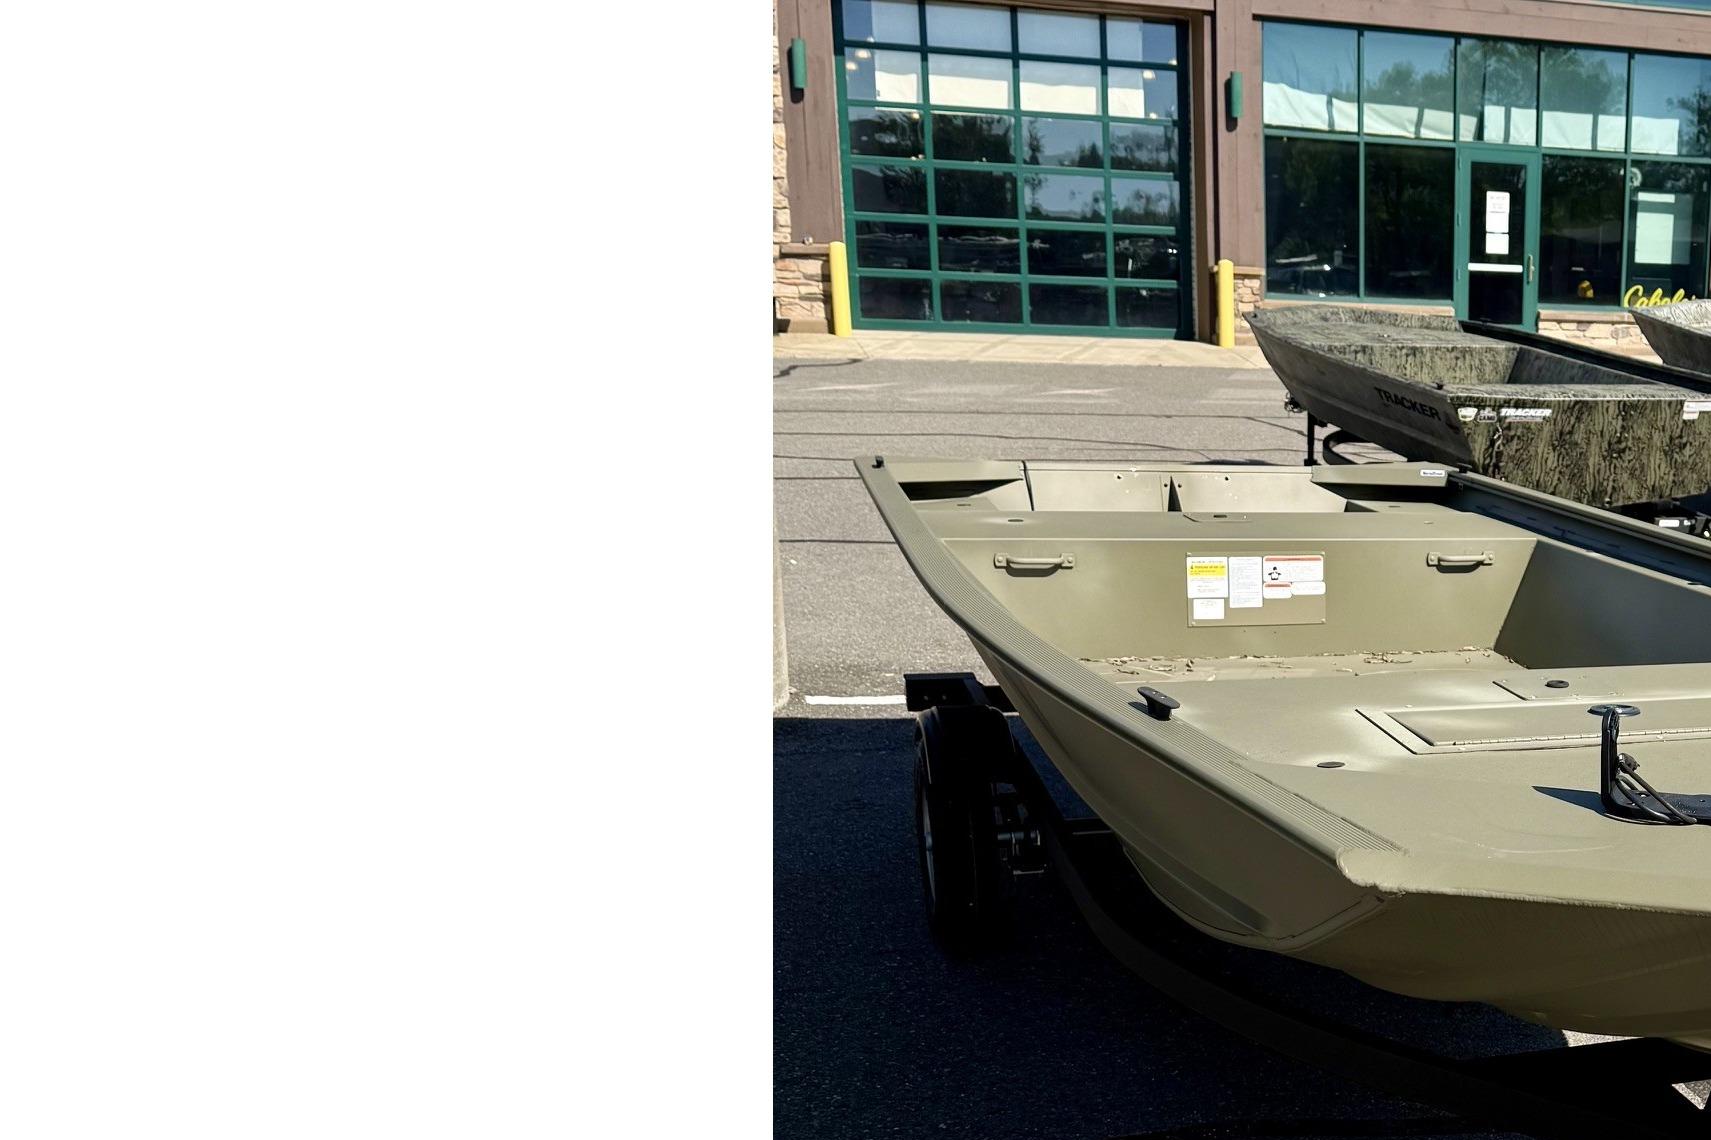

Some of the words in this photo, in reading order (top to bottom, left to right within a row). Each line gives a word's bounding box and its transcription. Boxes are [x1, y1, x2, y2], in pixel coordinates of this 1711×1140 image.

[1624, 285, 1696, 308] Cabel'
[1374, 386, 1441, 421] TRACKER
[1500, 408, 1552, 416] TRACKER
